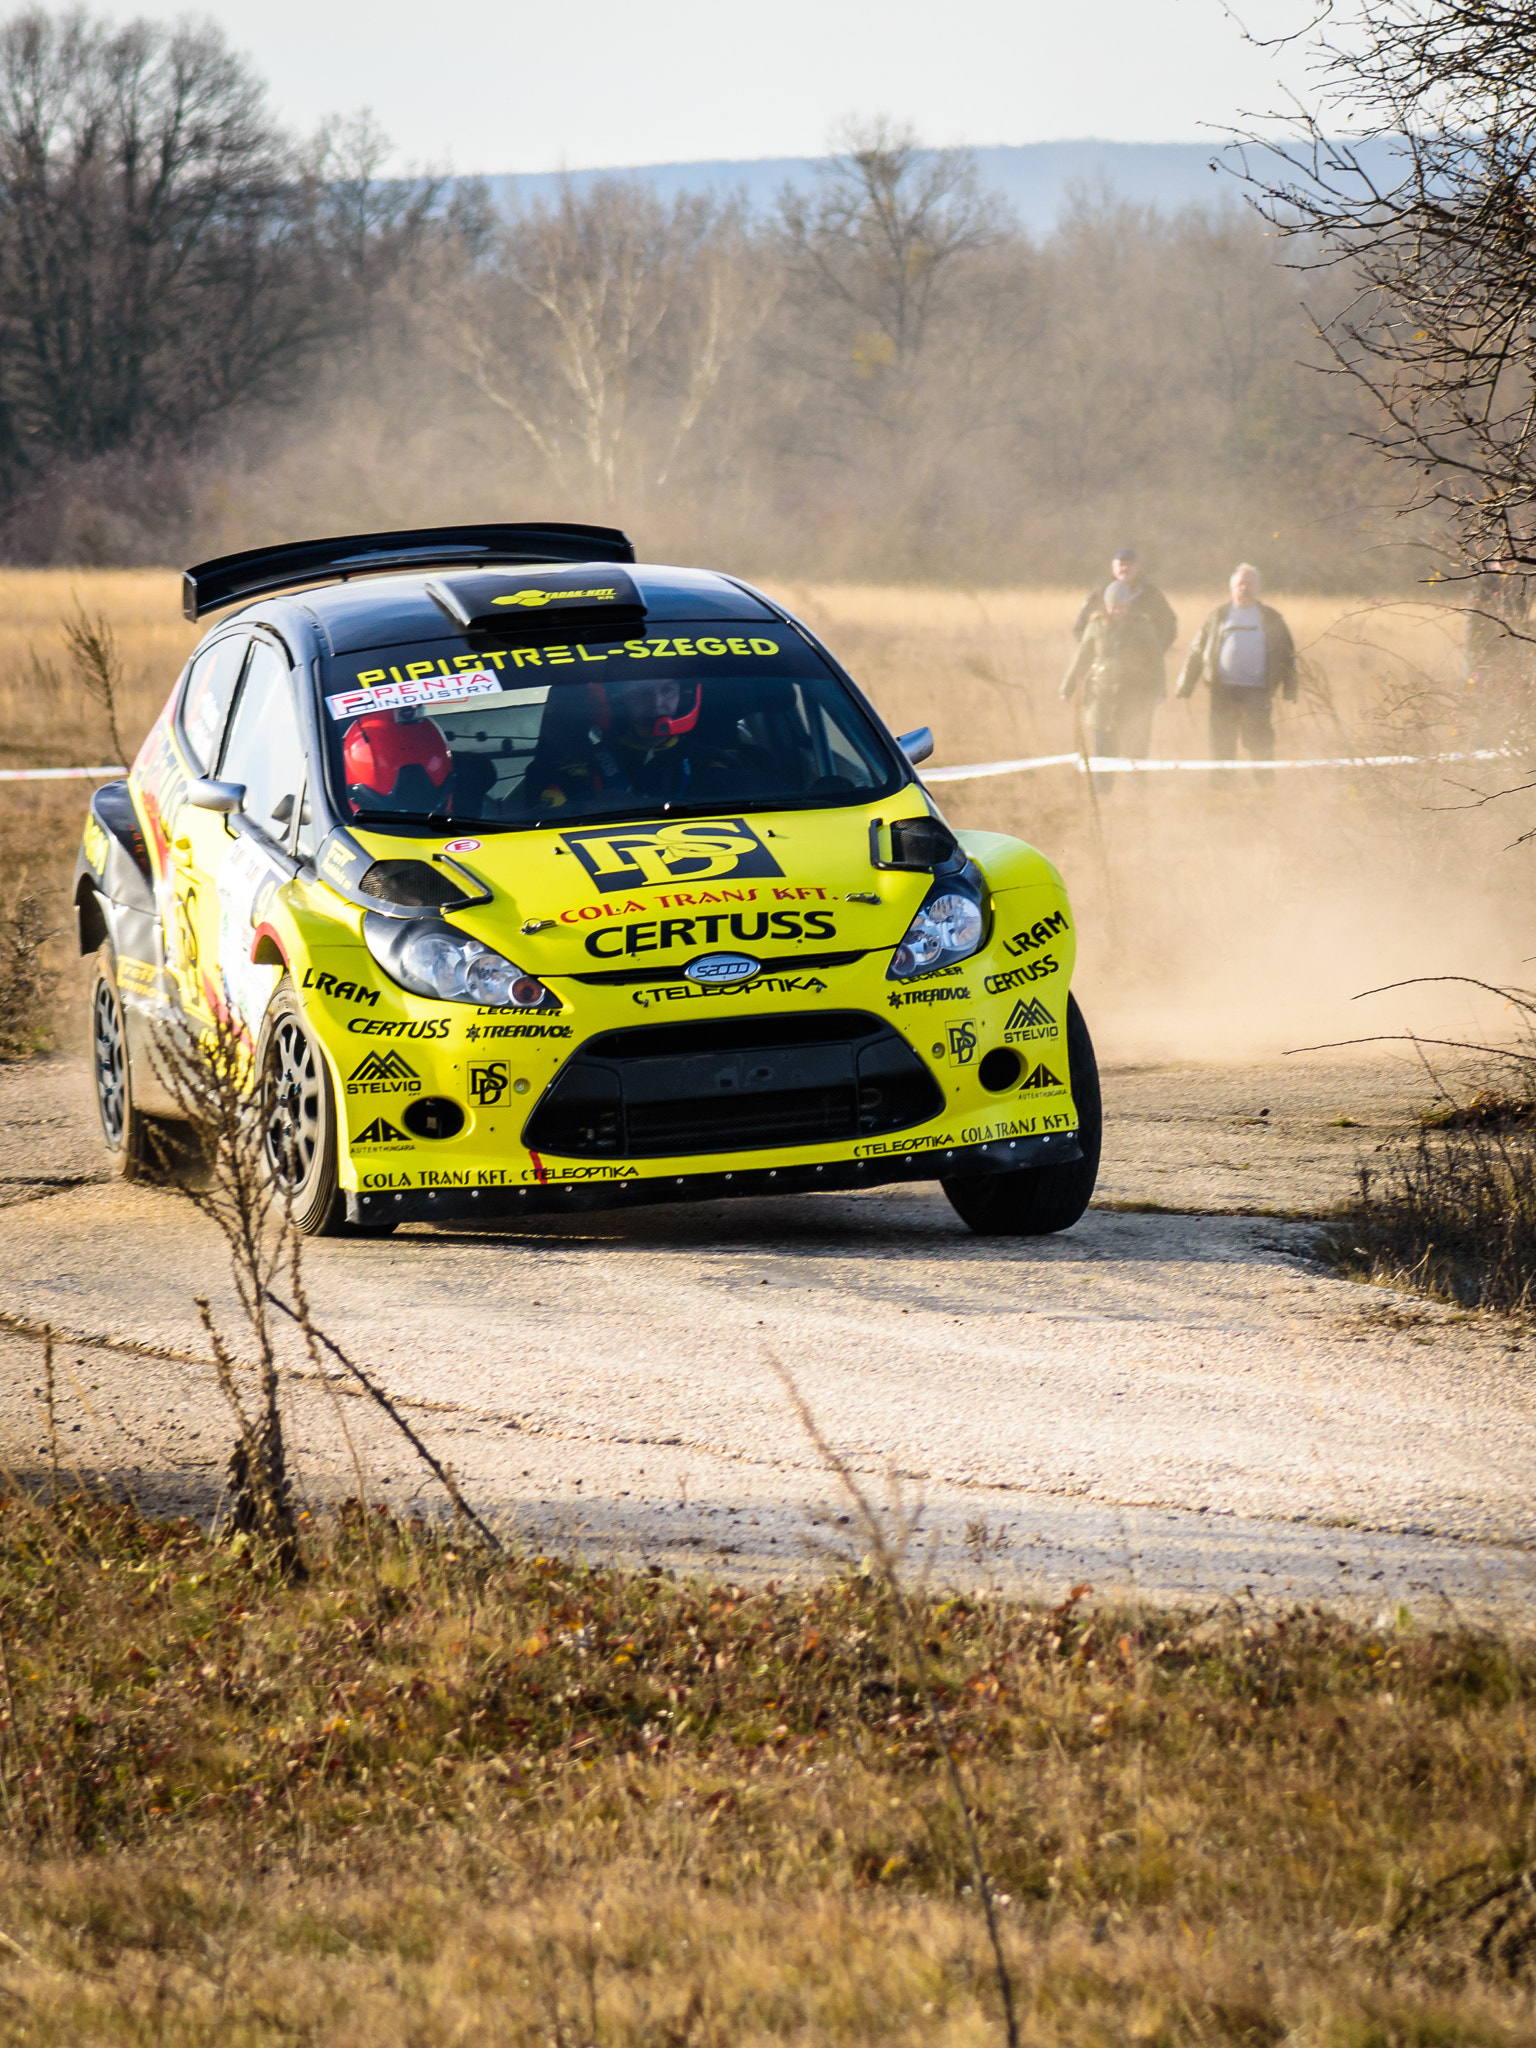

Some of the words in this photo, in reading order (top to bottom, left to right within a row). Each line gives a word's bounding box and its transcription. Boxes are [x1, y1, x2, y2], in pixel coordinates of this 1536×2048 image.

[374, 673, 493, 699] PENTA
[378, 683, 494, 708] INDUSTRY
[560, 900, 647, 924] COLA
[654, 888, 759, 909] TRANS
[772, 887, 839, 901] KFT.
[585, 911, 837, 958] CERTUSS
[1003, 910, 1069, 957] LRAM
[302, 968, 381, 1006] LRAM
[984, 954, 1059, 995] CERTUSS
[347, 1018, 452, 1039] CERTUSS
[1004, 1025, 1059, 1043] STELVIO
[346, 1080, 422, 1094] STELVIO
[961, 1126, 993, 1143] COLA
[995, 1117, 1037, 1138] TRANS
[363, 1171, 412, 1188] COLA
[418, 1170, 471, 1186] TRANS
